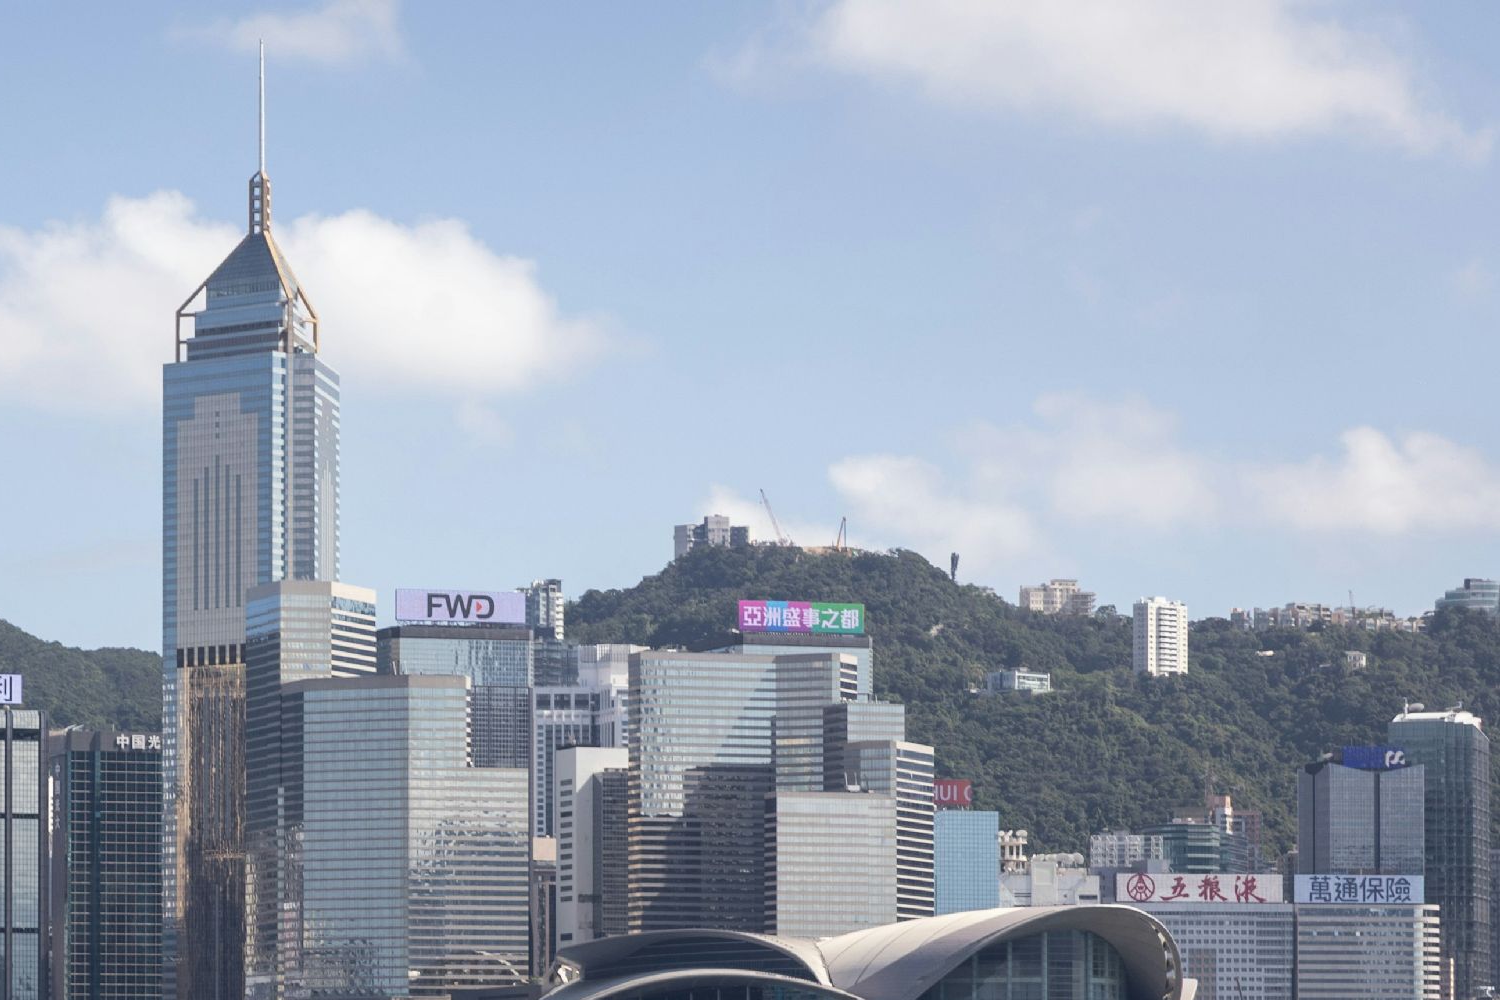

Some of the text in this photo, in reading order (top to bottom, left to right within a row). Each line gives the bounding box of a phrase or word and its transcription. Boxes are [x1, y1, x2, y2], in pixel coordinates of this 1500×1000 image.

[427, 593, 495, 619] FWD
[743, 605, 859, 629] 亞洲盛事之都
[1309, 876, 1412, 903] 萬通保險
